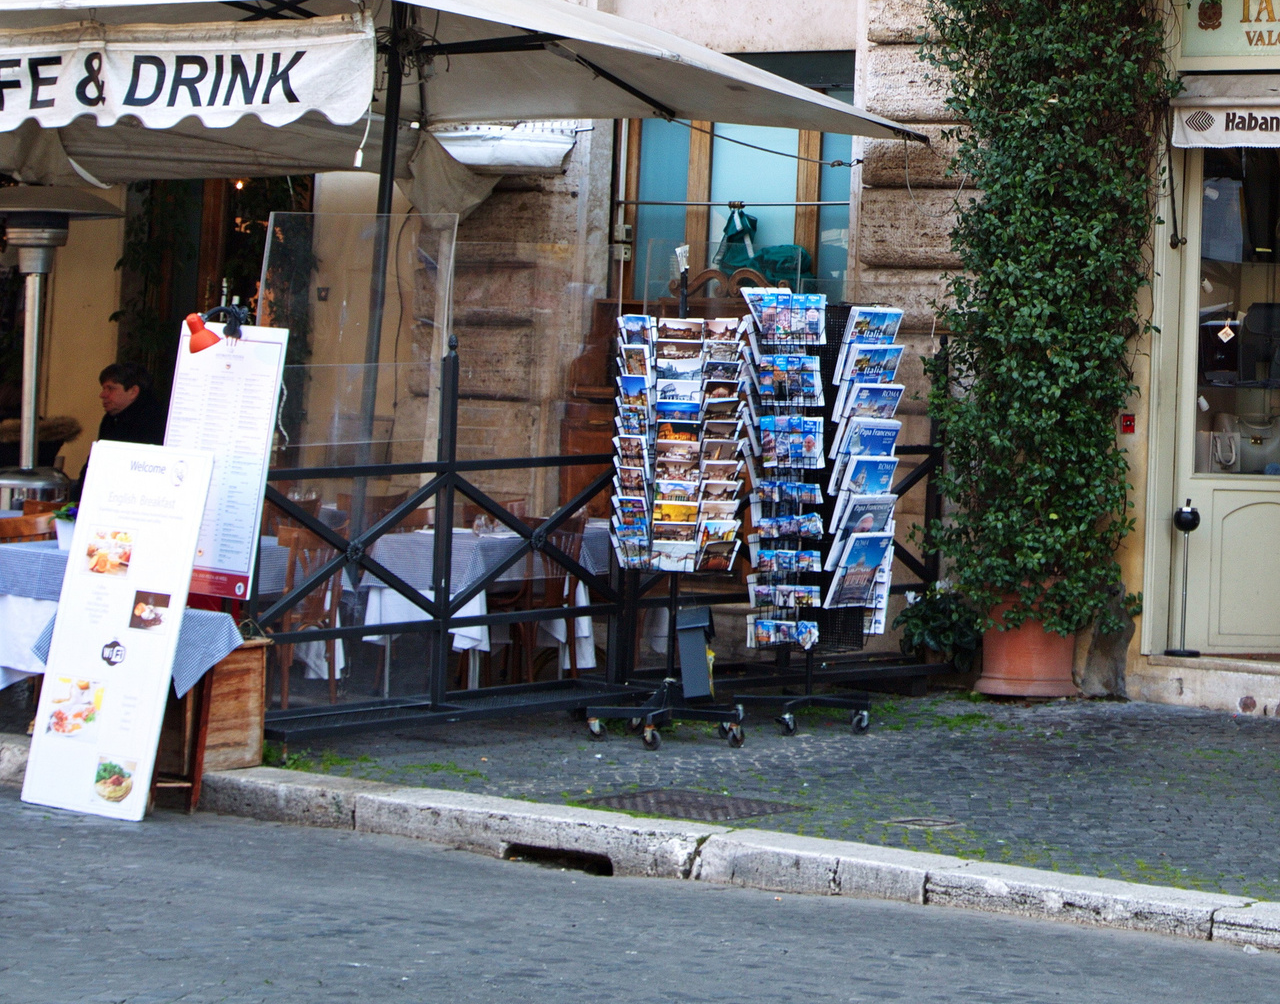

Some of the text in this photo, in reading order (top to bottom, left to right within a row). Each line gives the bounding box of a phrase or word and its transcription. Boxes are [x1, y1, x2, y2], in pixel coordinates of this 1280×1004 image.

[75, 51, 105, 107] &
[122, 50, 307, 107] DRINK
[863, 329, 883, 338] Italia
[863, 365, 883, 375] Italia
[882, 390, 900, 398] ROMA
[860, 428, 896, 437] Papa Francesco
[130, 460, 167, 475] Welcome
[108, 491, 176, 509] English Breakfast
